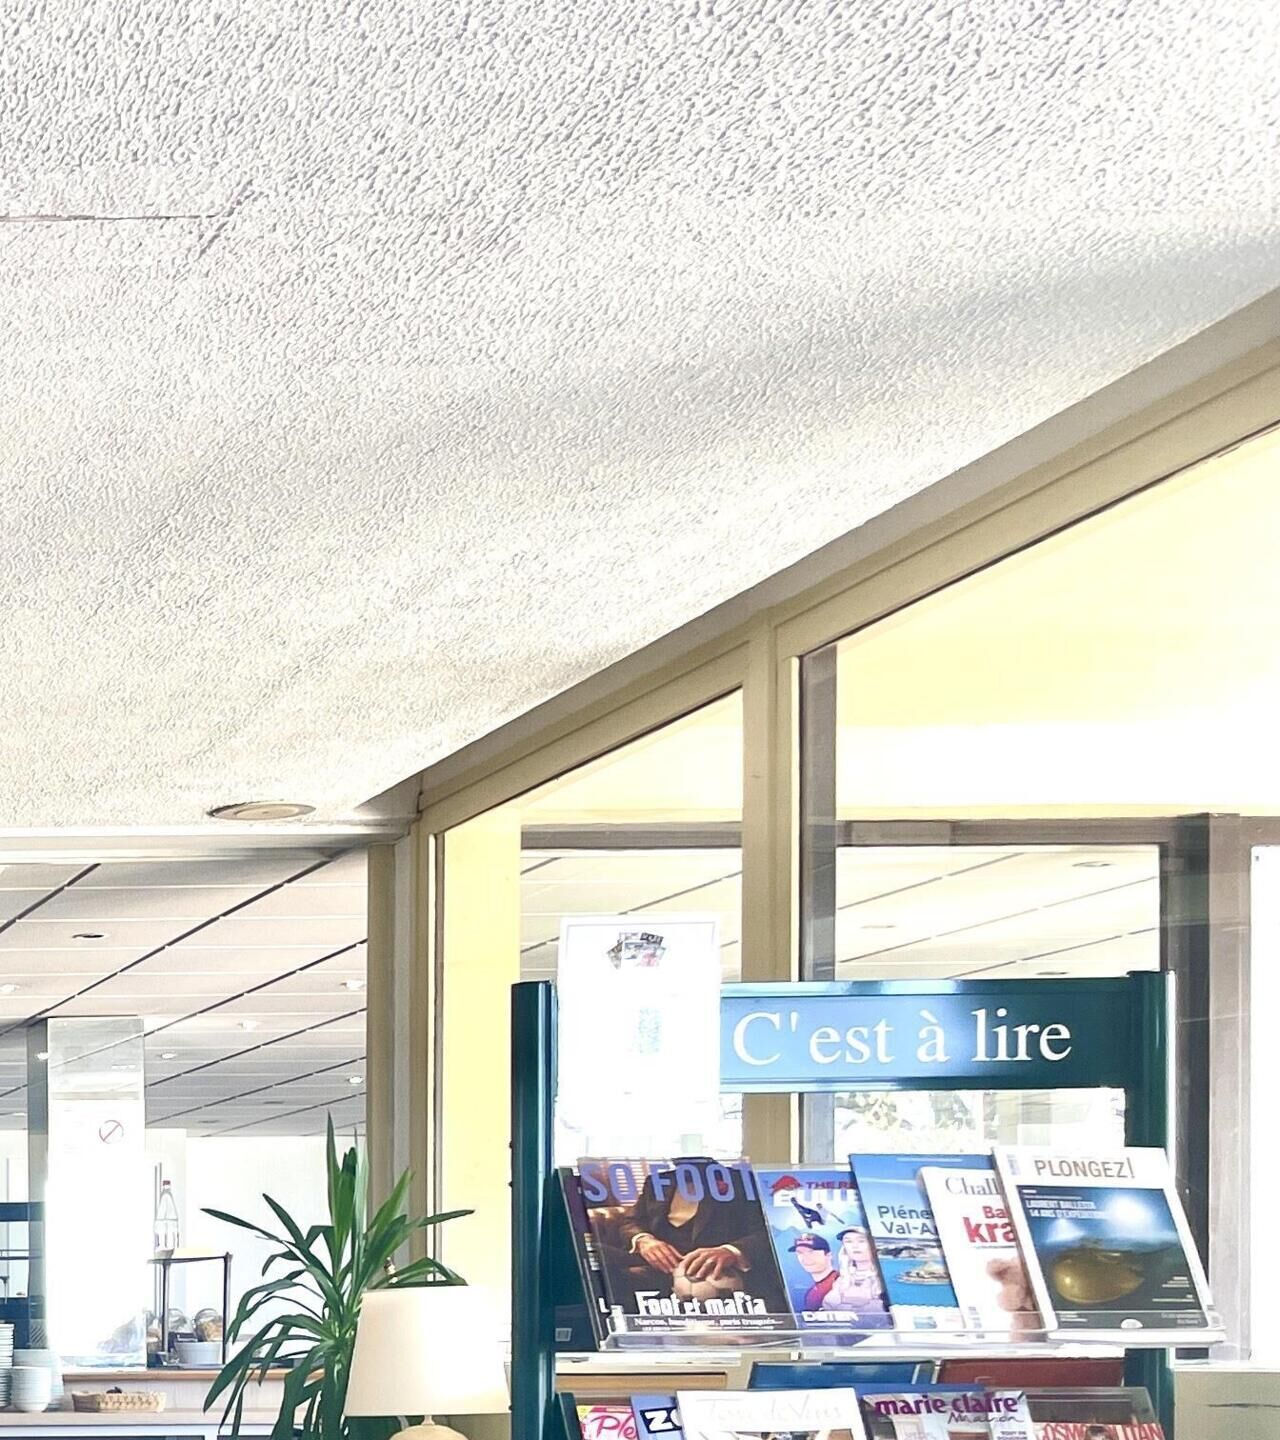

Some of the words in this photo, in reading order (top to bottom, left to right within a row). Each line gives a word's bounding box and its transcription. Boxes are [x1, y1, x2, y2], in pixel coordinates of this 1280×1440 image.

[732, 1010, 895, 1066] C'est
[915, 1009, 951, 1063] à
[970, 1007, 1072, 1062] lire
[1034, 1156, 1136, 1179] PLONGEZ!
[579, 1162, 640, 1202] SO
[648, 1162, 757, 1202] FOOT
[634, 1290, 681, 1316] Foot
[683, 1299, 703, 1316] et
[704, 1291, 768, 1316] mafia
[875, 1395, 947, 1417] marie
[951, 1394, 1019, 1414] claire
